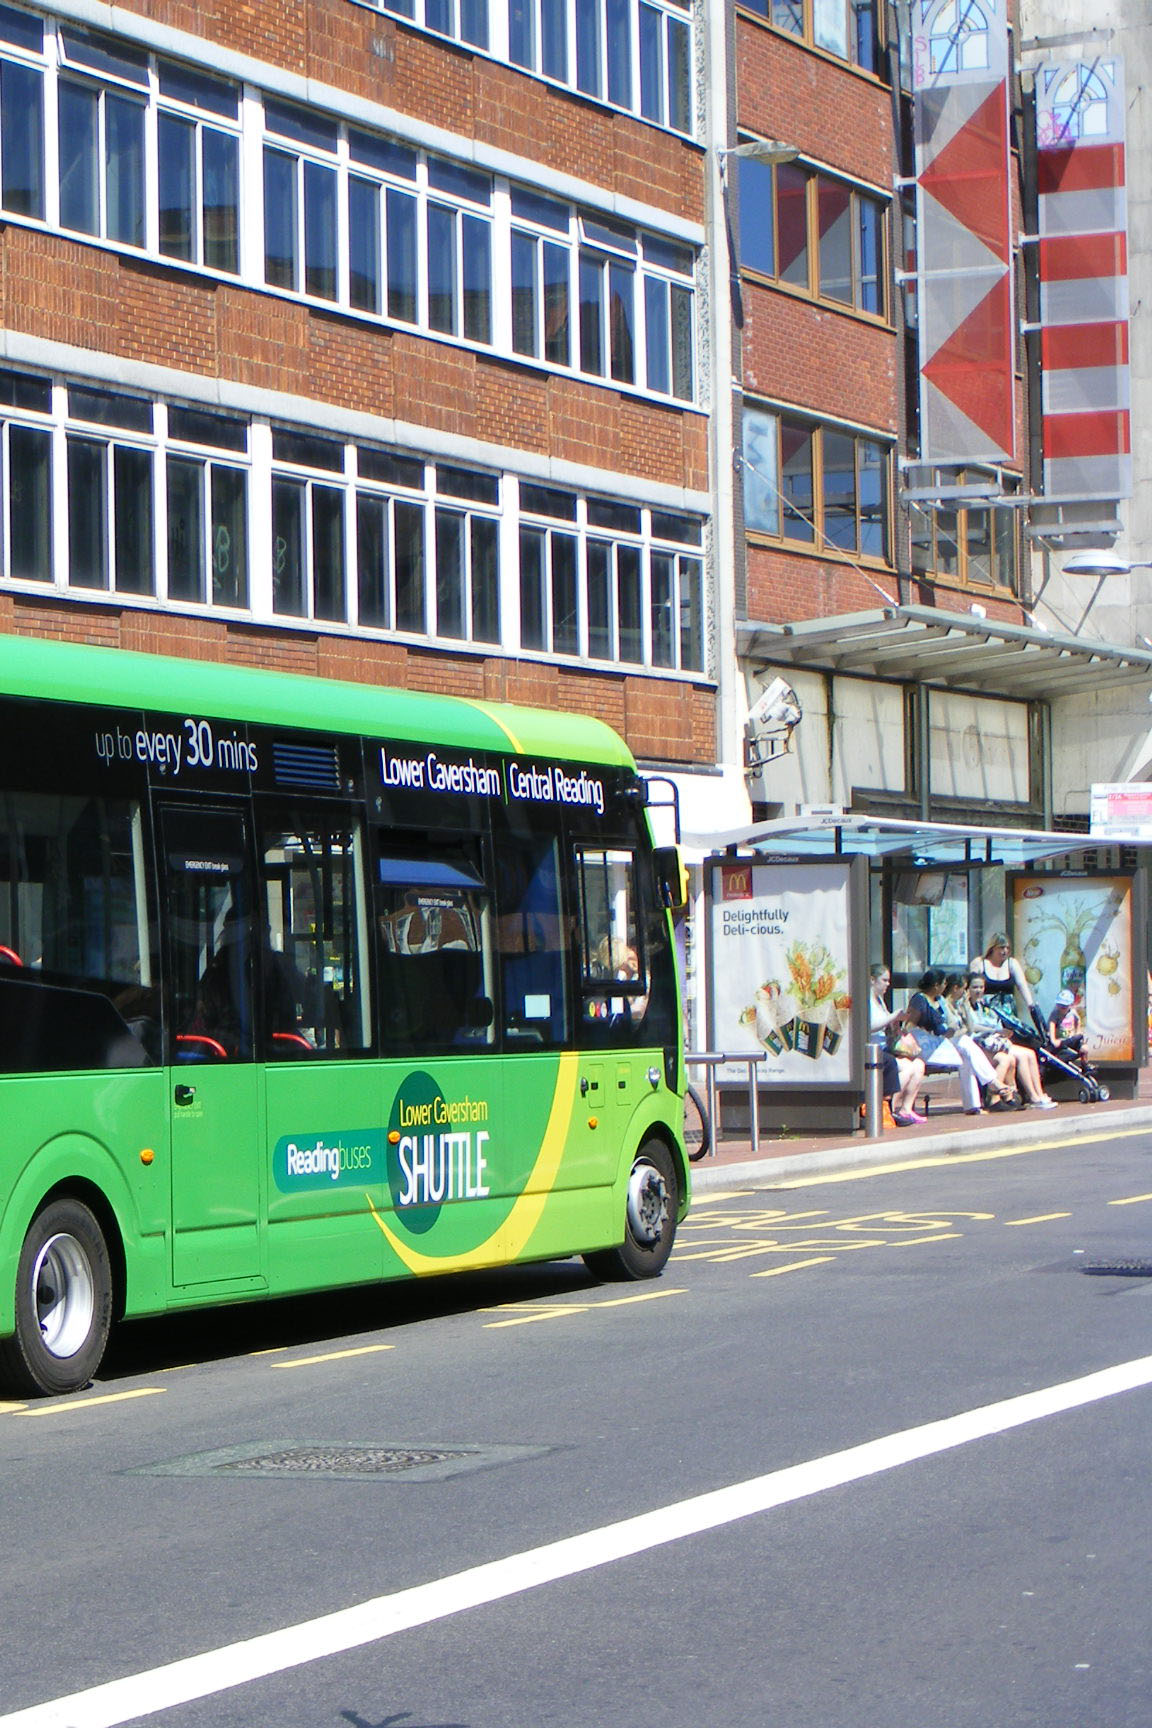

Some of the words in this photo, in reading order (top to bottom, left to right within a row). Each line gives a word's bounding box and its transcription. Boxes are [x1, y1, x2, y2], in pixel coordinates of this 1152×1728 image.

[96, 732, 114, 767] up
[117, 725, 132, 760] to
[135, 730, 182, 775] every
[184, 718, 214, 767] 30
[217, 731, 258, 772] mins
[380, 747, 425, 788] Lower
[426, 752, 501, 796] Caversham
[509, 762, 554, 802] Central
[555, 768, 604, 815] Reading
[723, 909, 789, 923] Delightfully
[723, 924, 784, 936] Deli-cious.
[399, 1099, 432, 1127] Lower
[434, 1096, 488, 1124] Caversham
[398, 1131, 491, 1206] SHUTTLE
